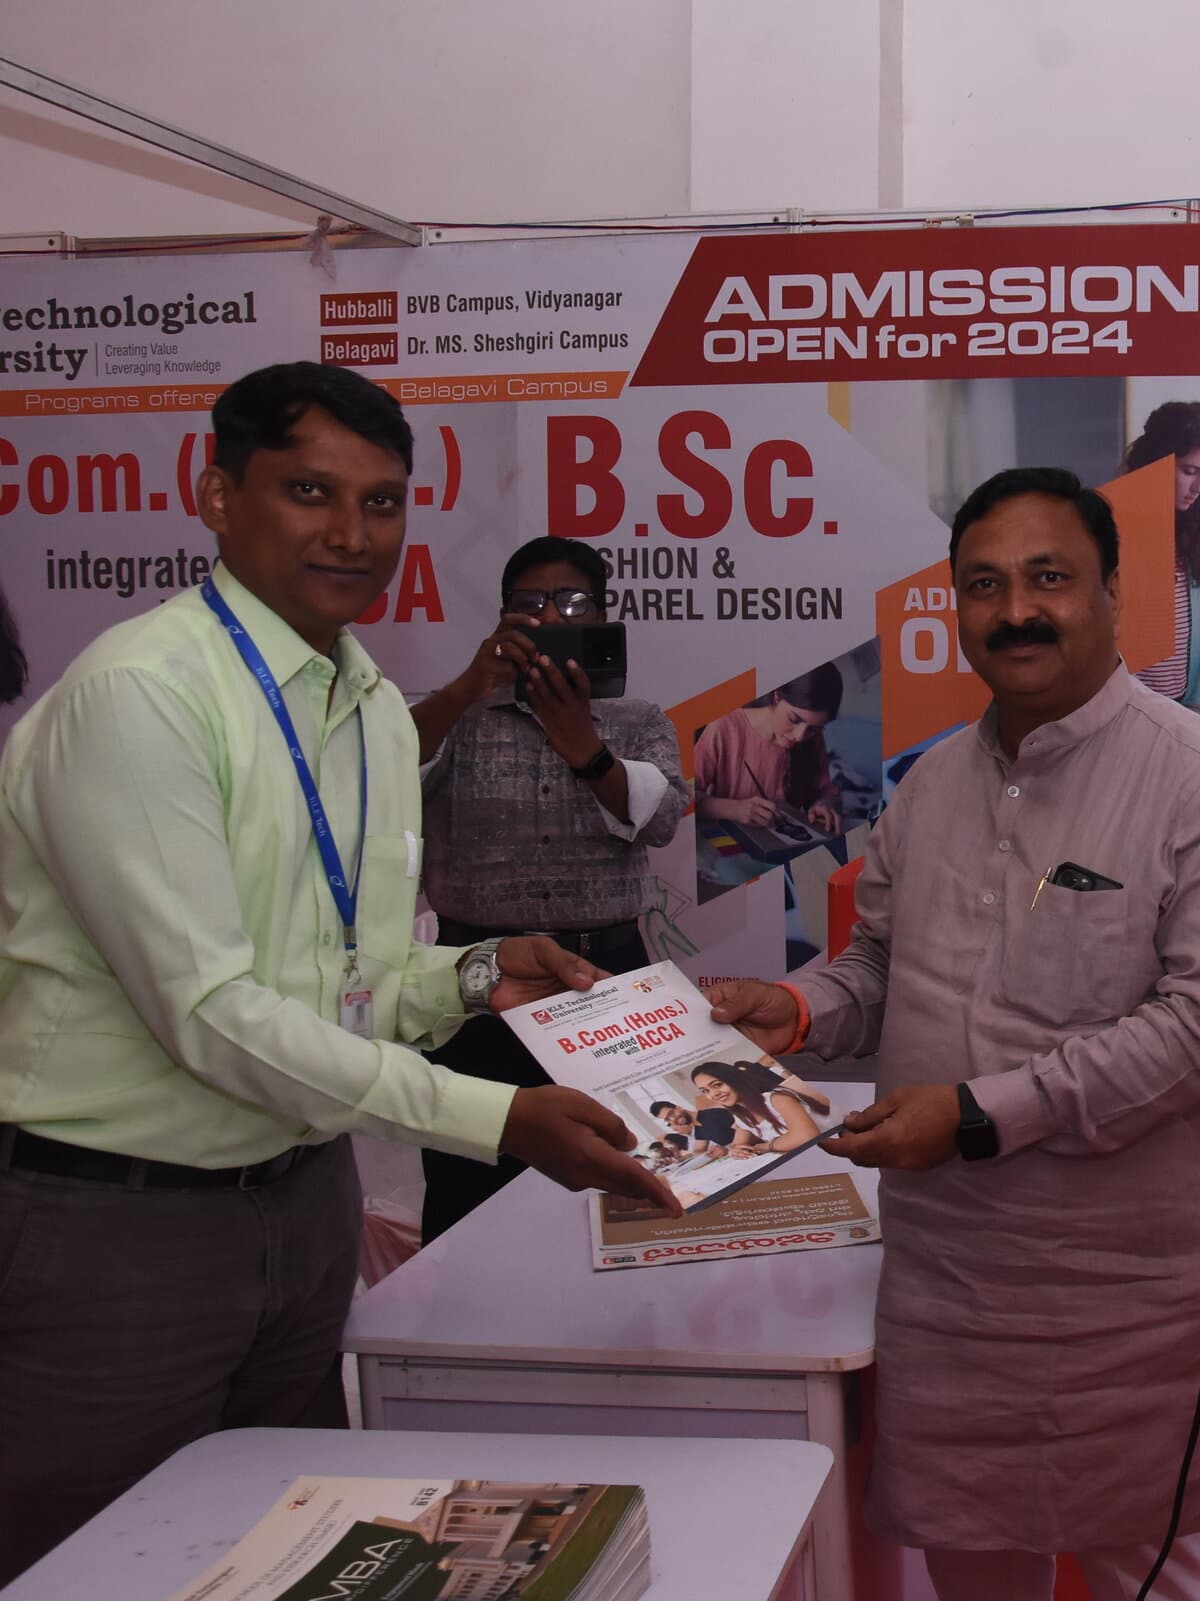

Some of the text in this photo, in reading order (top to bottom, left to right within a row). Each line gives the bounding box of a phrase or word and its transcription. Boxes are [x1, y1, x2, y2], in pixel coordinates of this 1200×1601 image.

[0, 291, 257, 334] echnological
[325, 299, 393, 319] Hubballi
[407, 289, 622, 316] BVB Campus, Vidyanagar
[105, 342, 178, 358] Creating Value
[325, 338, 395, 362] Belagavi
[407, 330, 629, 355] Dr. MS. Sheshgiri Campus
[703, 320, 1133, 363] OPEN for 2024
[0, 340, 88, 381] rsity
[105, 360, 221, 376] Leveraging Knowledge
[25, 377, 607, 412] Programs offere Belagavi Campus
[546, 410, 838, 539] B.Sc.
[47, 549, 221, 597] integrate
[597, 546, 735, 579] SHION &
[604, 587, 843, 621] PAREL DESIGN
[547, 1002, 565, 1014] KLE
[566, 986, 618, 1008] Technological
[552, 1003, 593, 1020] University
[557, 999, 689, 1055] B.Com.(Hons.)
[592, 1036, 637, 1059] integrated
[636, 1022, 686, 1051] ACCA
[624, 1045, 641, 1056] with
[309, 1538, 403, 1601] MBA
